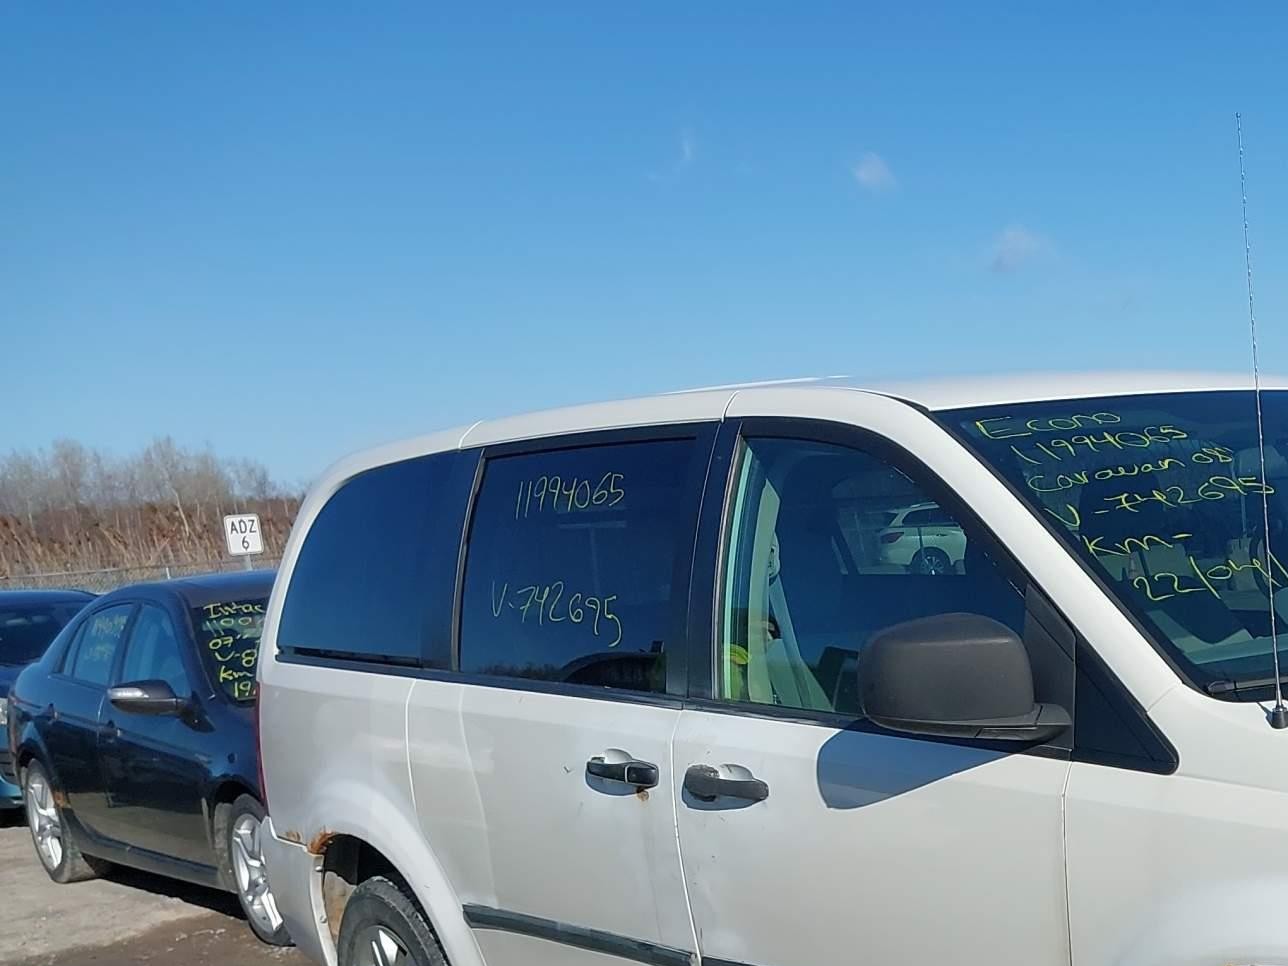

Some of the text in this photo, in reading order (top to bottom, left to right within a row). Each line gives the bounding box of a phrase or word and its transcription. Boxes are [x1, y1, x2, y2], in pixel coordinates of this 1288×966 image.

[1010, 425, 1188, 465] 11994065
[514, 471, 626, 520] 11994065
[230, 518, 258, 535] ADZ
[240, 535, 251, 551] 6
